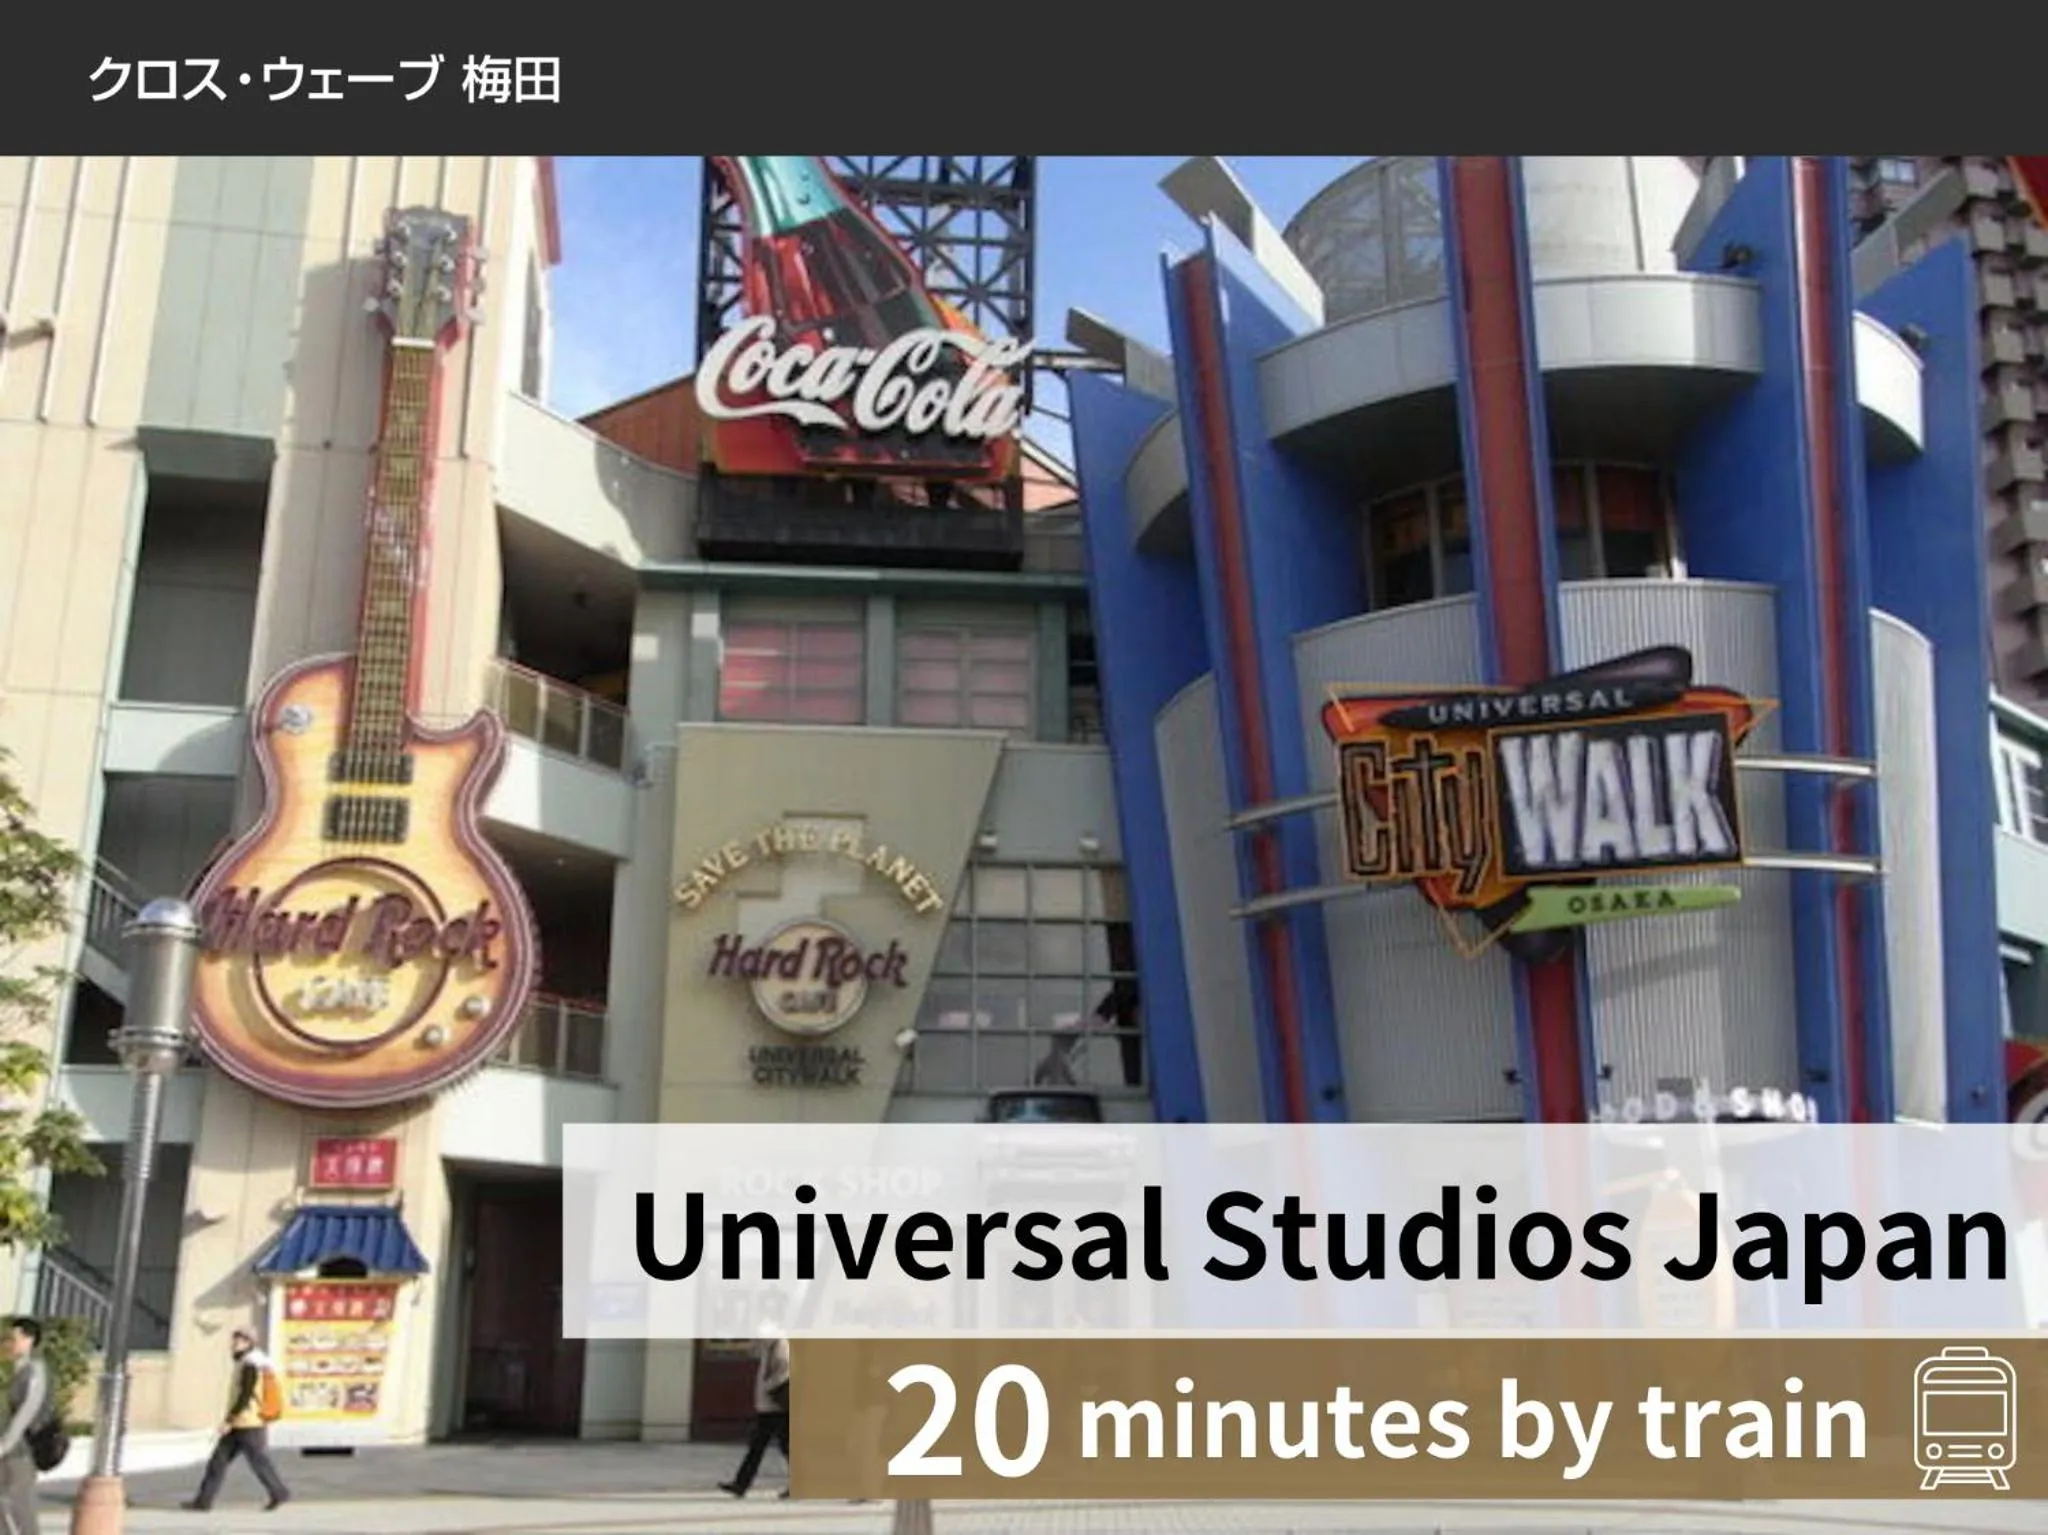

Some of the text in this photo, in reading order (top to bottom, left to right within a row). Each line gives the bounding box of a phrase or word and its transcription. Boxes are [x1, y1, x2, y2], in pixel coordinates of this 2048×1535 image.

[694, 313, 1036, 439] Coca-Cola
[1427, 688, 1634, 725] UNIVERSAL
[1499, 730, 1735, 867] WALK
[673, 824, 944, 915] SAVE THE PLANET
[200, 886, 502, 970] Hard Rock
[1568, 889, 1677, 915] OSAKA
[708, 932, 910, 989] Hard Rock
[748, 1046, 867, 1065] UNIVERSAL
[752, 1064, 861, 1085] CITYWALK
